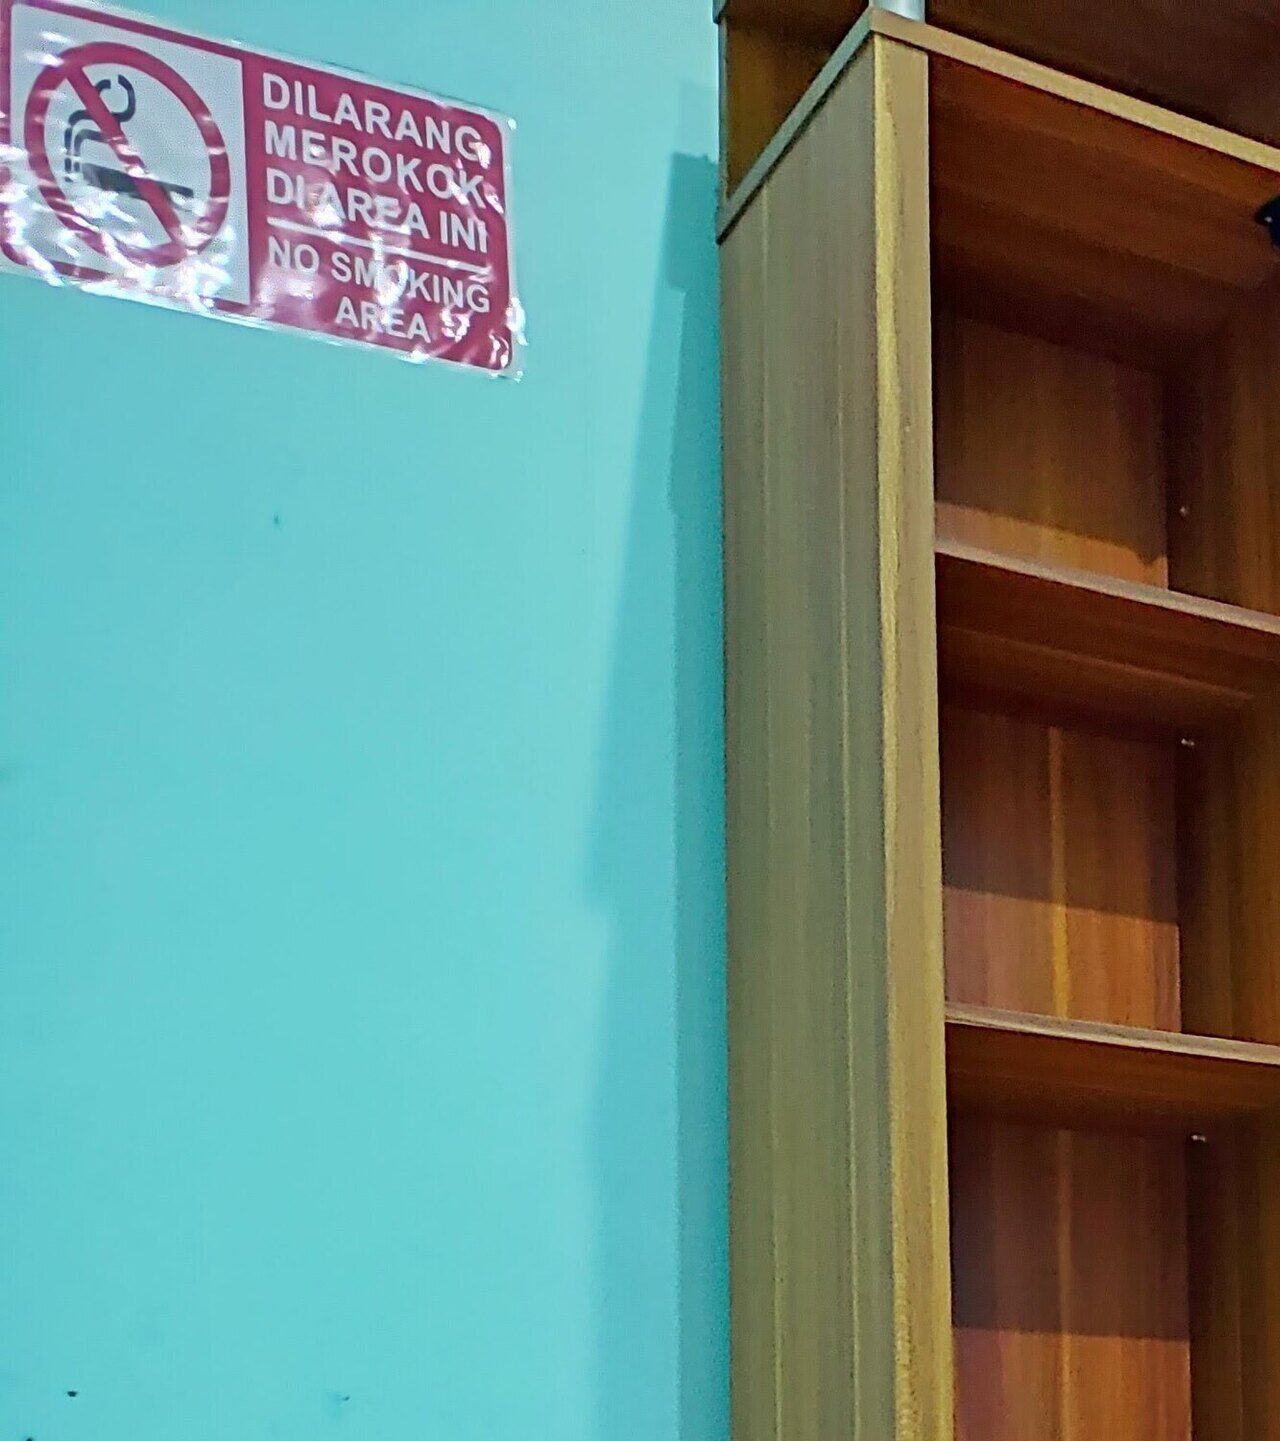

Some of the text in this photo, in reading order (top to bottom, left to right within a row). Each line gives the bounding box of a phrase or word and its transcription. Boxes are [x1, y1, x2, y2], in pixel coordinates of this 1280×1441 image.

[262, 72, 489, 161] DILARANG
[264, 120, 487, 208] MEROKOK
[266, 167, 488, 253] DI AREA INI
[268, 236, 490, 313] NO SMOKING
[335, 296, 431, 343] AREA
